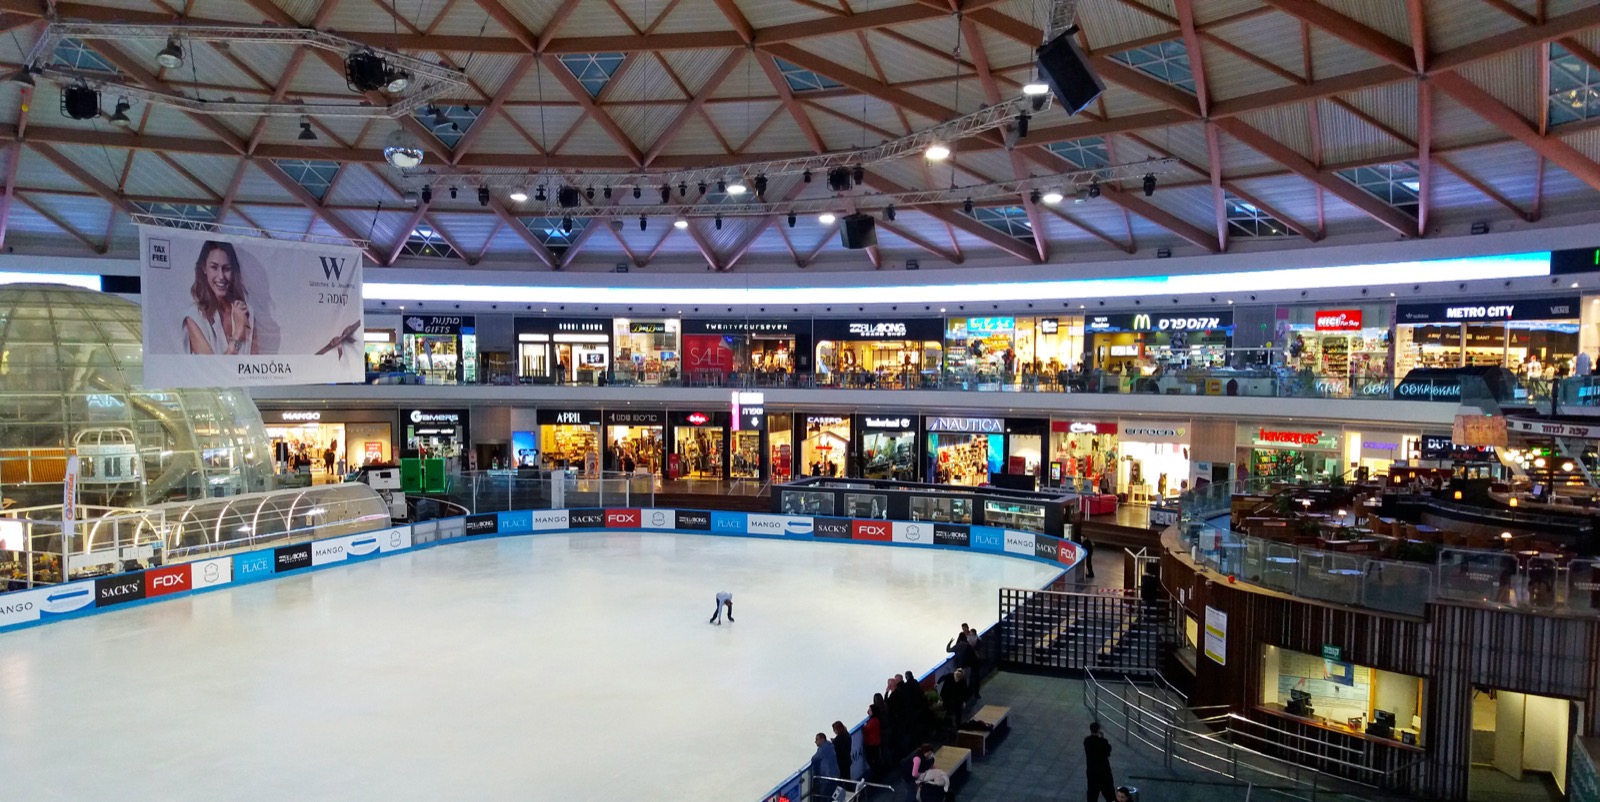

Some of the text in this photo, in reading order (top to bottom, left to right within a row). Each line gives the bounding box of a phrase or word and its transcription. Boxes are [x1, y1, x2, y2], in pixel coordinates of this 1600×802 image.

[153, 245, 166, 254] TAX
[152, 254, 168, 263] FREE
[319, 256, 345, 280] W
[318, 293, 349, 306] קומה 2
[1446, 305, 1514, 318] METRO CITY
[431, 317, 460, 325] מתנות
[1159, 318, 1219, 330] אקספרס
[1317, 317, 1340, 327] NICI
[425, 326, 451, 334] GIFTS
[691, 347, 725, 365] SALE
[557, 412, 581, 423] APRIL
[937, 418, 1002, 431] NAUTICA
[1569, 427, 1589, 437] קפה
[502, 519, 527, 528] PLACE
[572, 515, 601, 523] SACK'S
[608, 514, 635, 522] FOX
[717, 520, 741, 528] PLACE
[859, 526, 885, 535] FOX
[975, 535, 999, 545] PLACE
[1007, 538, 1033, 548] MANGO
[316, 546, 343, 557] MANGO
[1036, 543, 1057, 554] SACK'S
[1060, 548, 1075, 560] FOX
[242, 560, 268, 573] PLACE
[153, 573, 184, 588] FOX
[101, 582, 139, 598] SACK'S
[0, 601, 33, 615] ANGO
